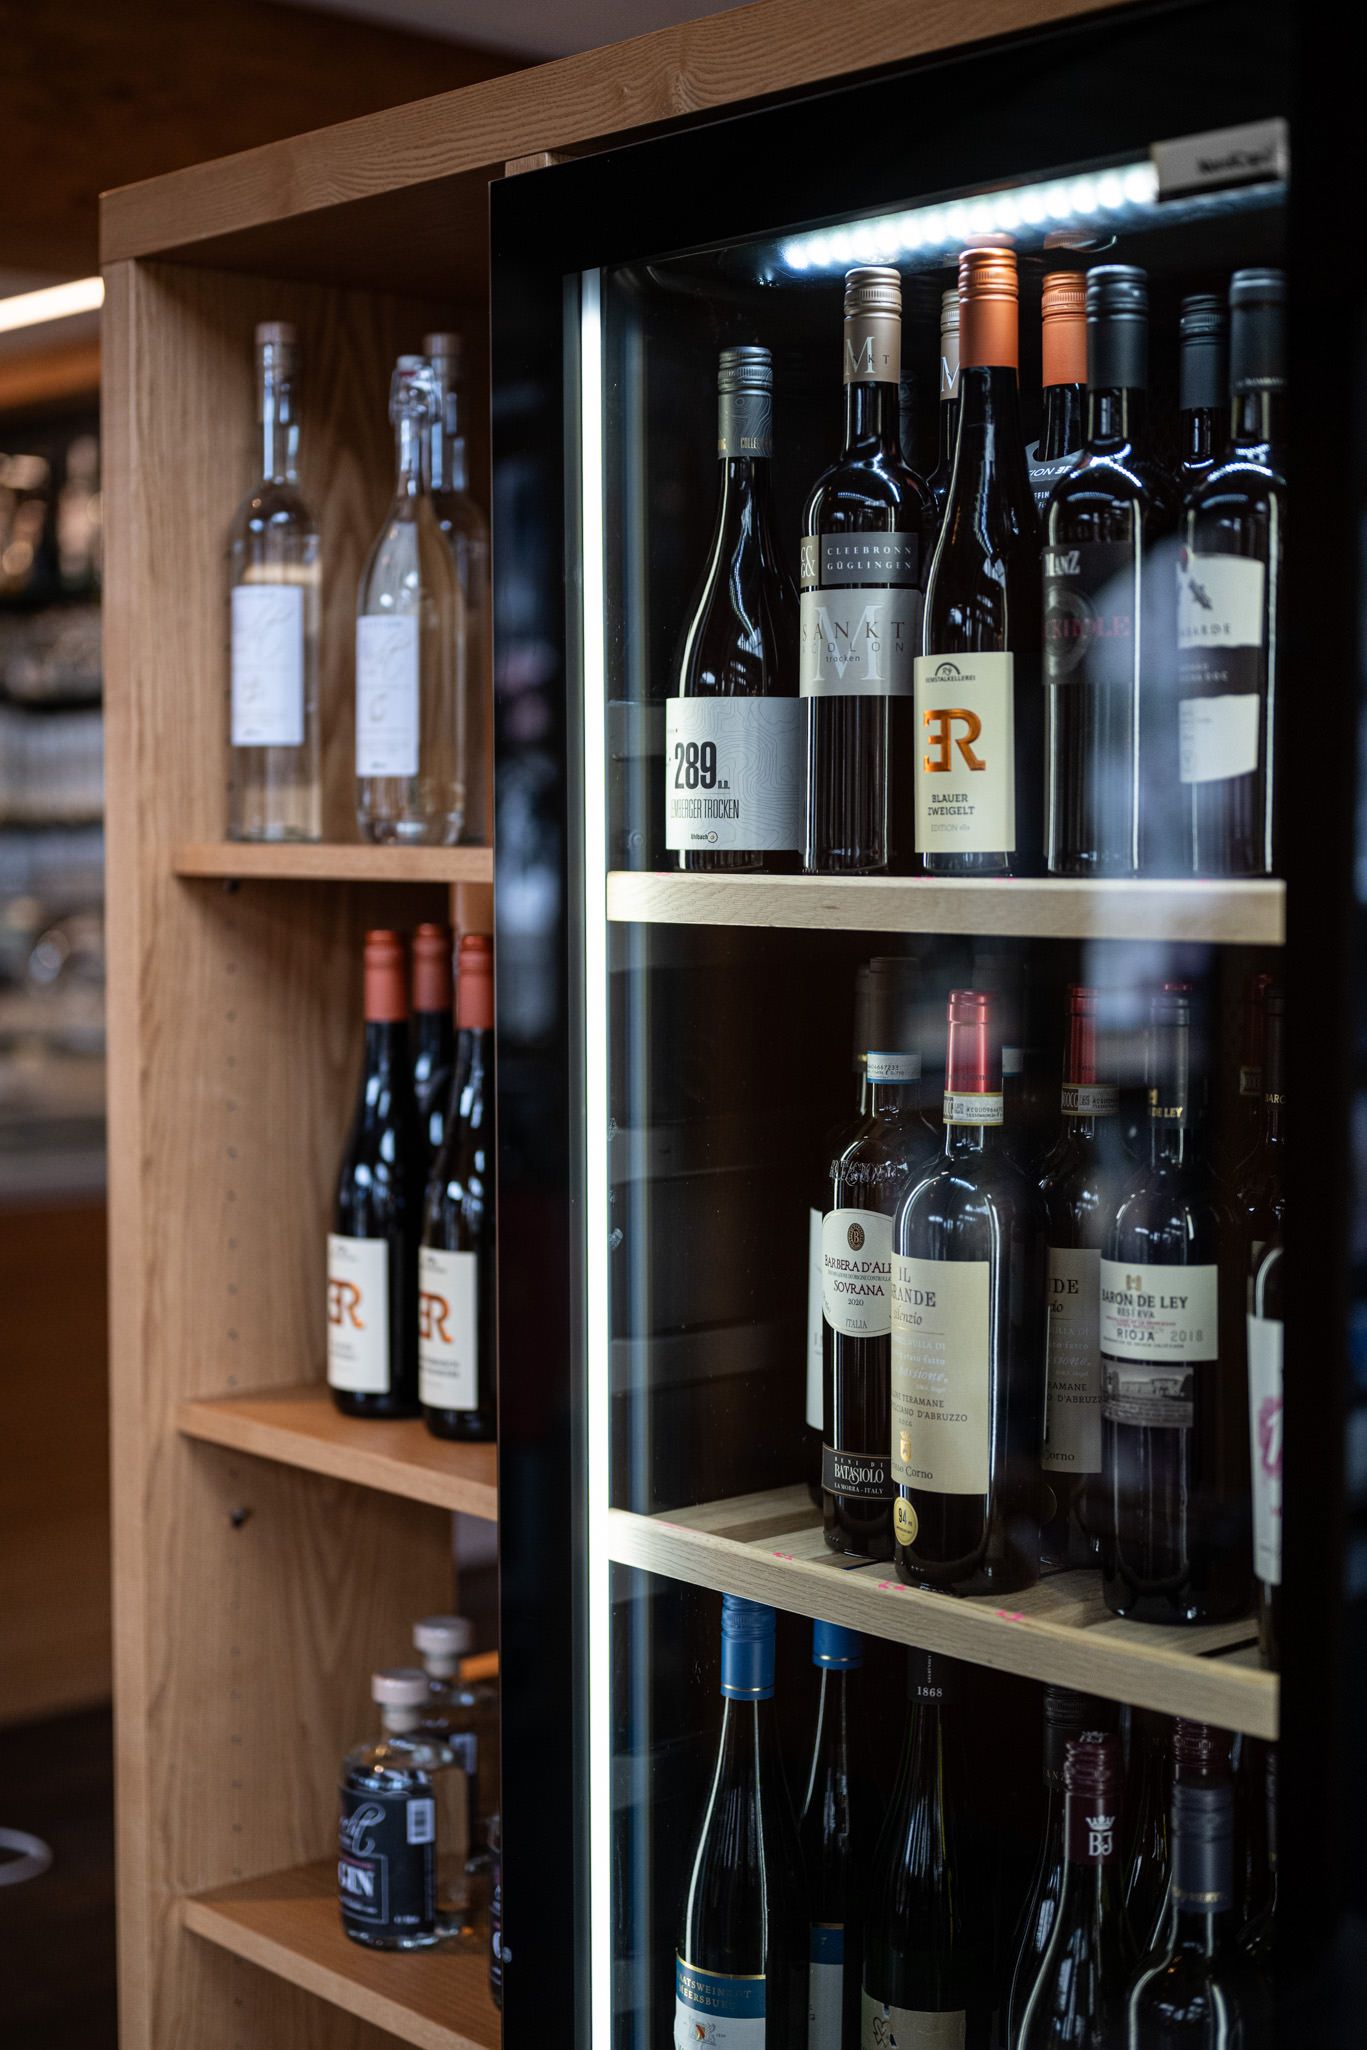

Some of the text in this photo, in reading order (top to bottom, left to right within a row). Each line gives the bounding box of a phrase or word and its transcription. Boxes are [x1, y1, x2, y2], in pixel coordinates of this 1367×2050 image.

[826, 545, 912, 556] CLEEBRONN
[826, 559, 912, 571] GÜGLINGEN
[802, 620, 906, 642] SANKT
[825, 654, 862, 663] trocken
[674, 741, 718, 790] 289
[931, 794, 969, 804] BLAUER
[703, 799, 740, 820] TROCKEN
[928, 806, 976, 816] ZWEIGELT
[1163, 1106, 1184, 1119] LEY
[824, 1254, 860, 1273] BARBERA
[898, 1266, 911, 1283] IL
[833, 1279, 885, 1297] SOVRANA
[1136, 1296, 1156, 1309] DE
[1159, 1296, 1189, 1310] LEY
[845, 1318, 868, 1329] ITALIA
[1116, 1328, 1156, 1342] RIOJA
[1169, 1330, 1205, 1343] 2018
[902, 1393, 945, 1408] TERAMANE
[917, 1410, 968, 1423] D'ABRUZZO
[834, 1462, 885, 1486] BATASIOLO
[905, 1464, 934, 1481] Corno
[864, 1485, 885, 1495] ITALY
[897, 1507, 909, 1525] 94
[916, 1685, 943, 1698] 1868
